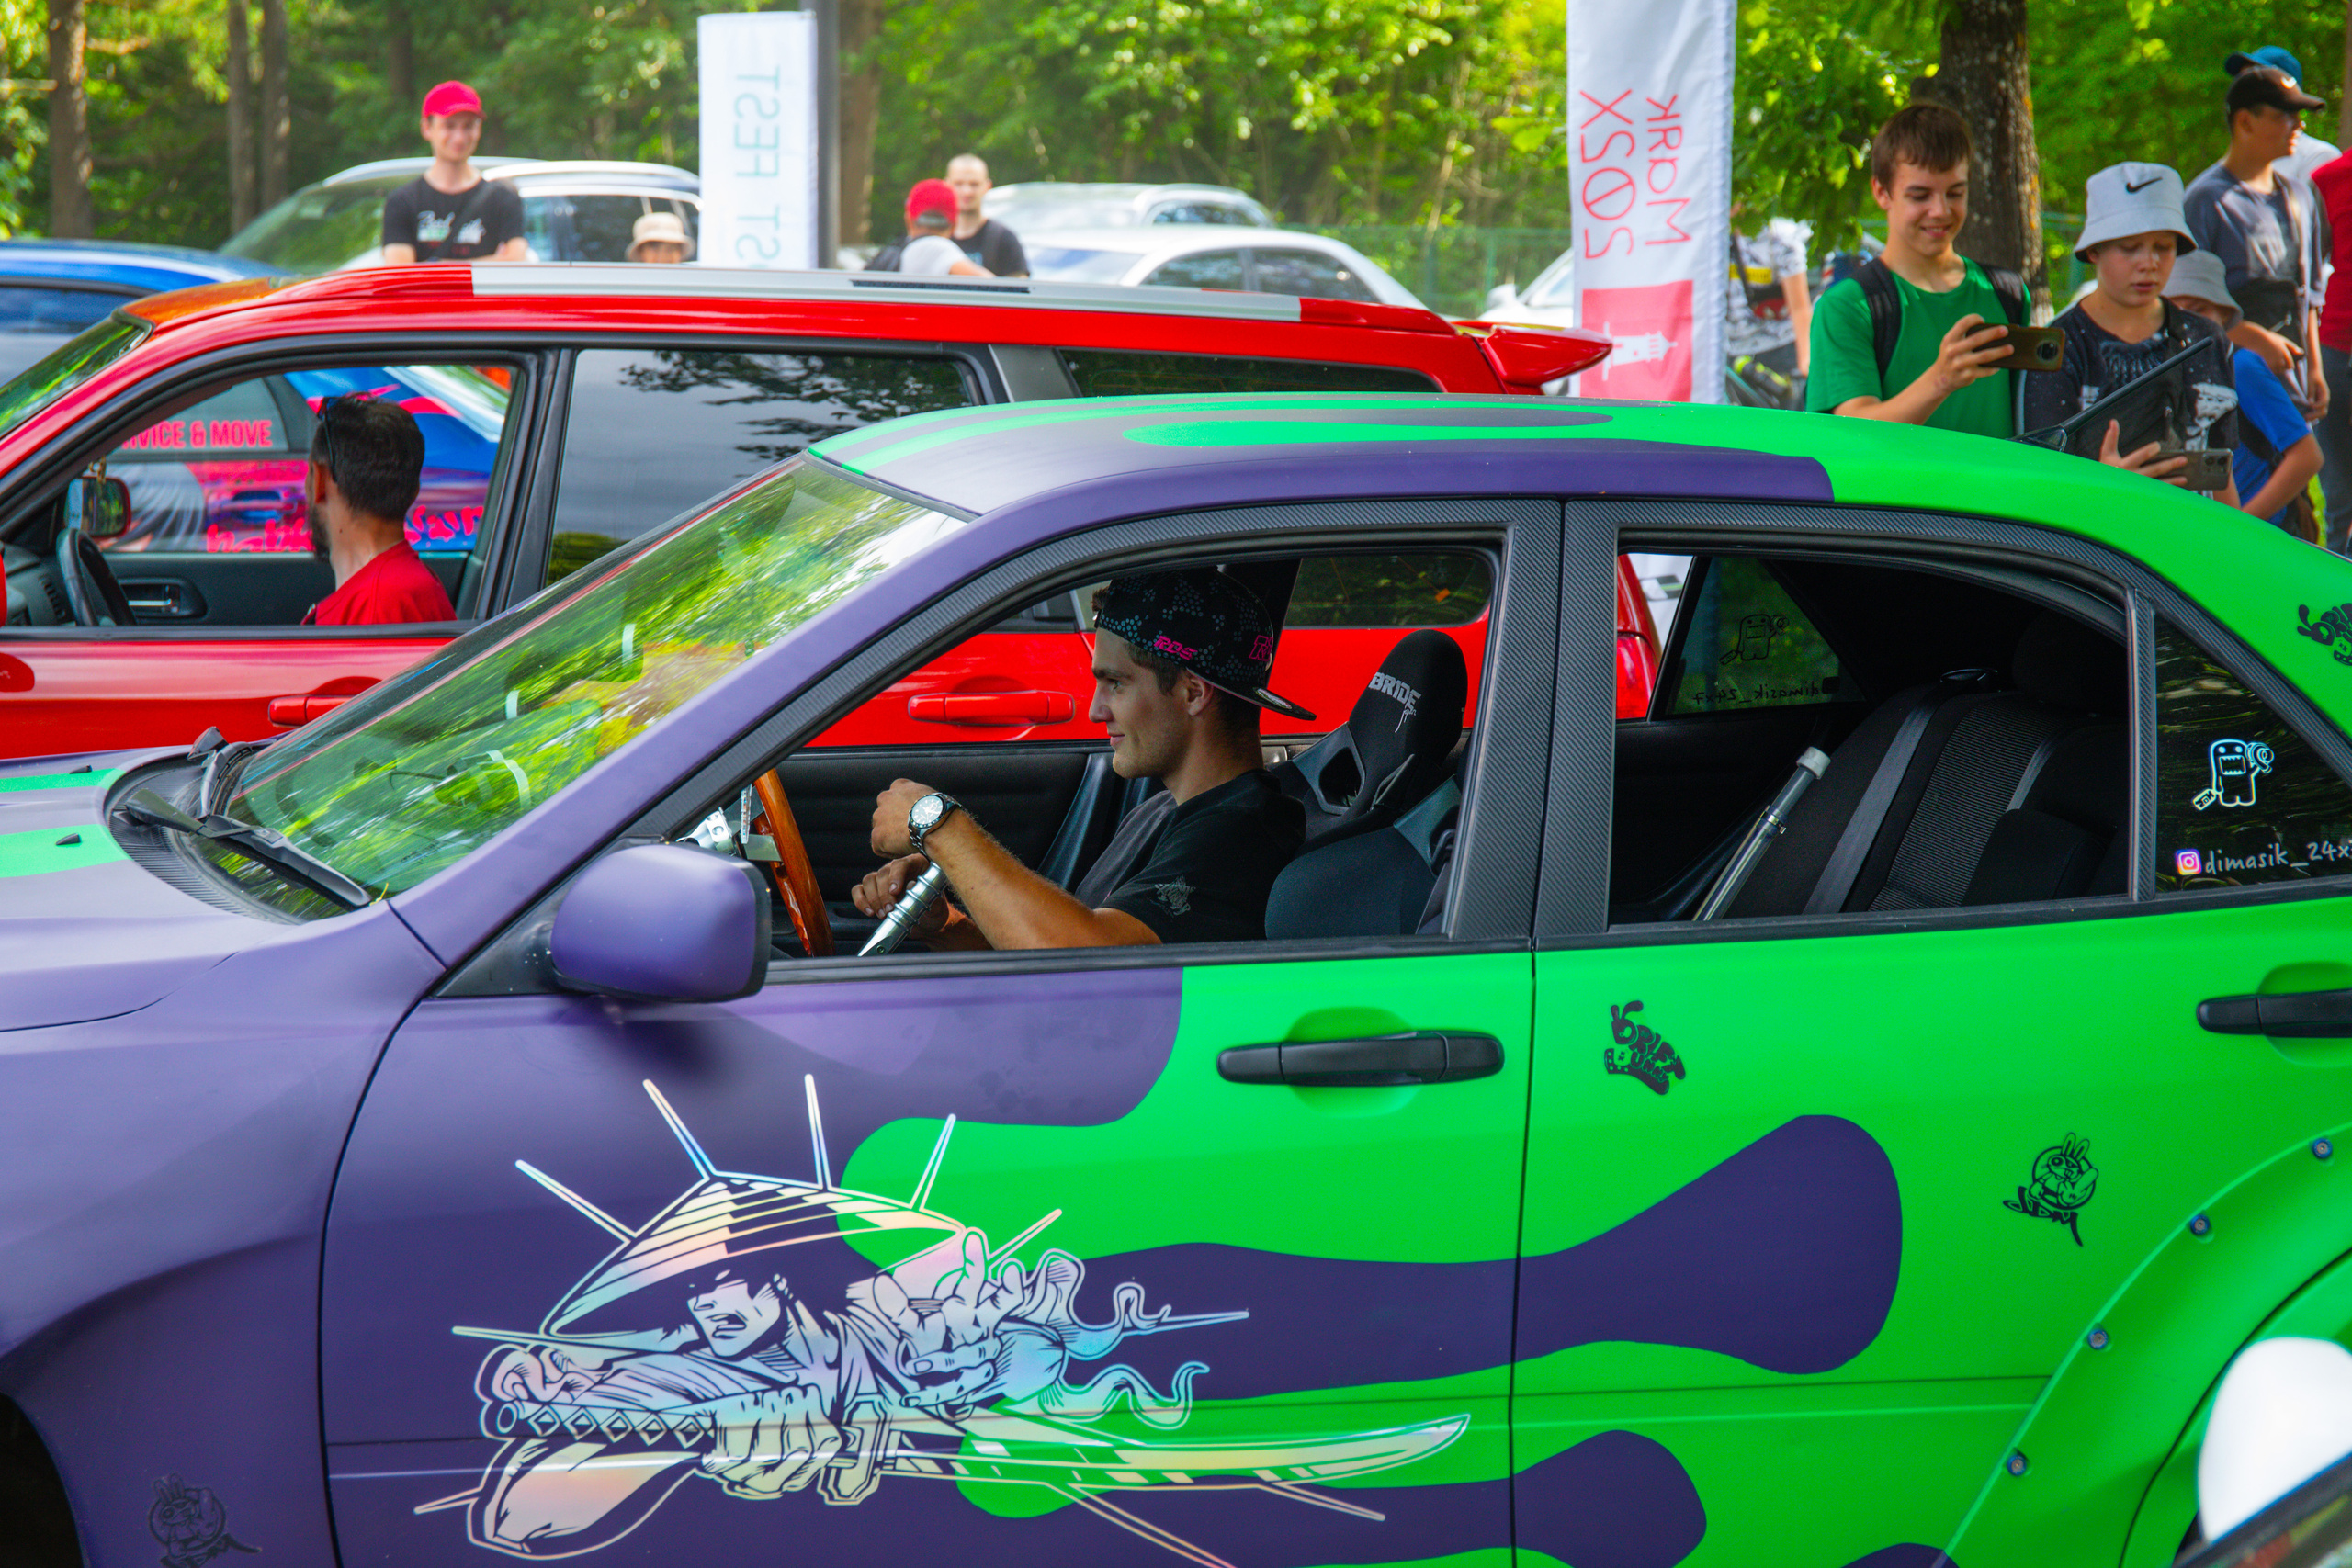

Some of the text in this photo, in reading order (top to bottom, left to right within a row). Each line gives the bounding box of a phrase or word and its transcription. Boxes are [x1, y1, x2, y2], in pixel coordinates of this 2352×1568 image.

[190, 421, 206, 447] &
[210, 420, 273, 447] MOVE
[1154, 635, 1198, 660] RDS
[1368, 671, 1422, 712] BRIDE
[2205, 840, 2352, 875] dimasik_24x
